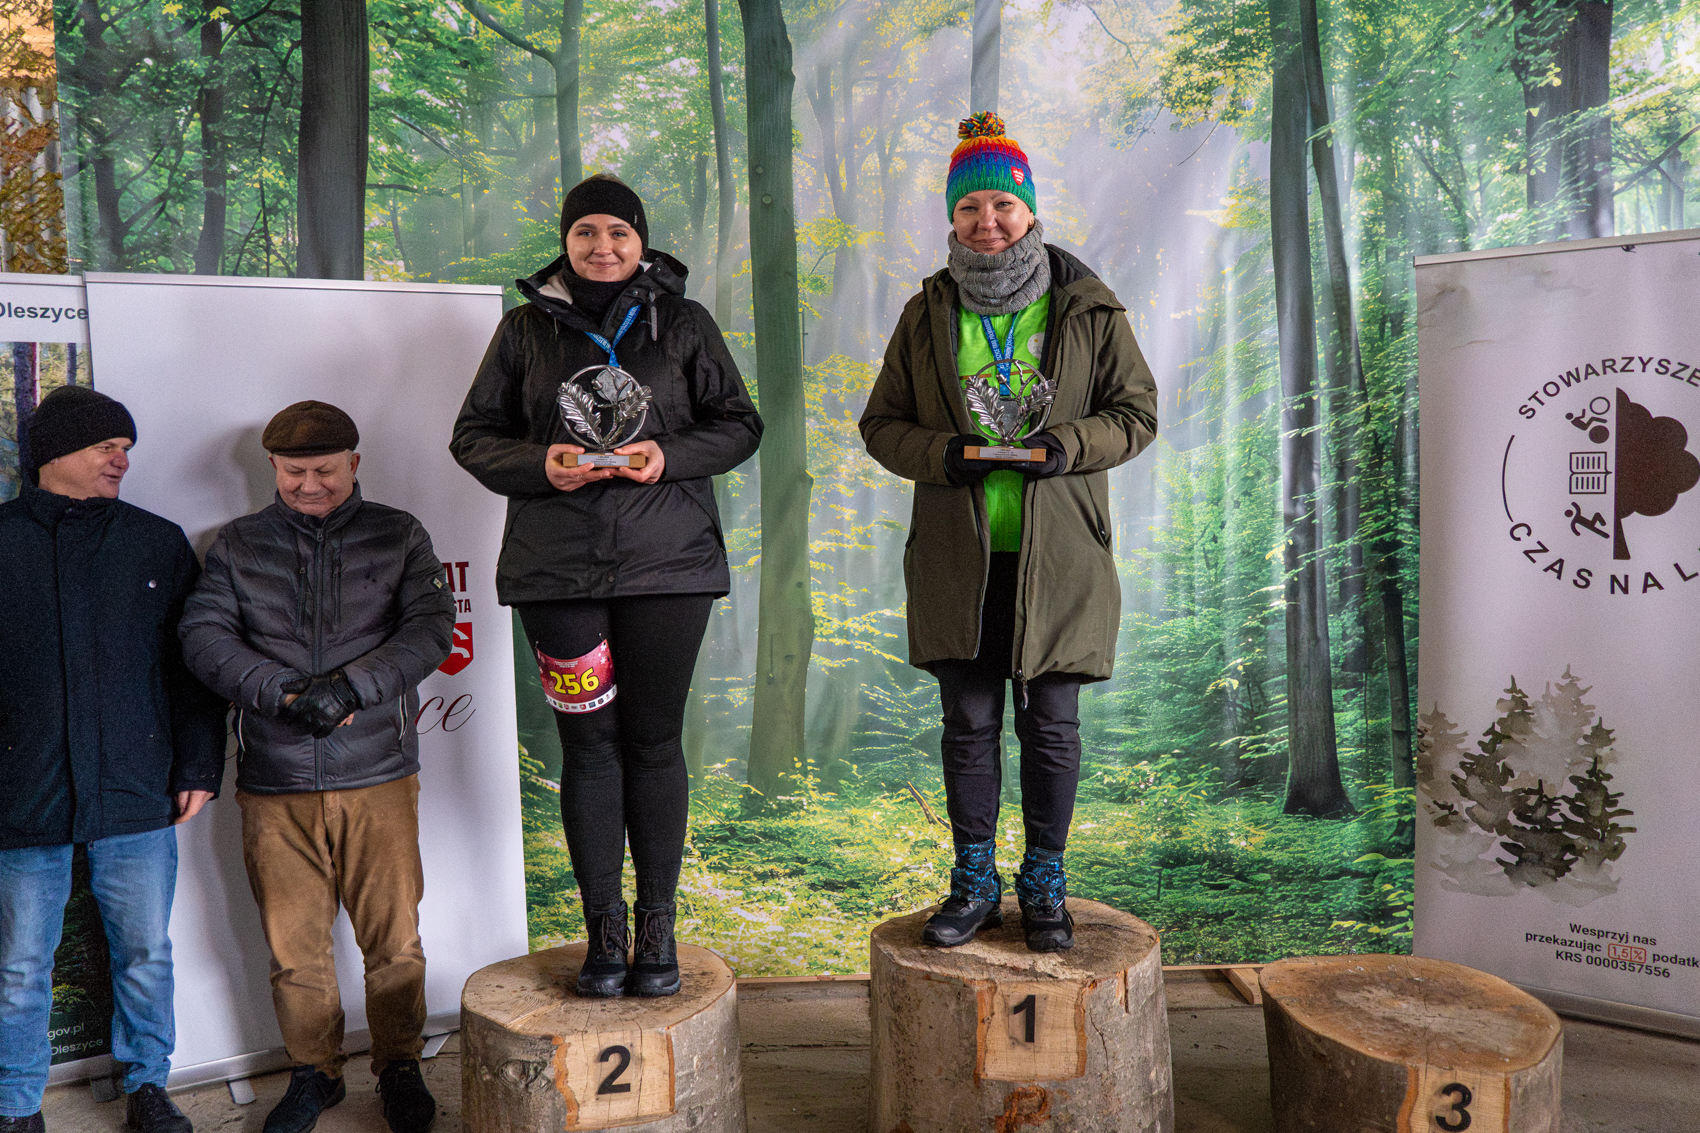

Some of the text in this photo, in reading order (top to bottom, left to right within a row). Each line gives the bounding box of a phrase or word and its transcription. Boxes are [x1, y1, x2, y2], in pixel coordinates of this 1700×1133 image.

[1518, 356, 1700, 420] STOWARZYSZE
[549, 666, 600, 695] 256
[1525, 932, 1602, 952] przekazując
[1652, 952, 1700, 968] podatk
[1569, 922, 1657, 946] Wesprzyj nas
[1555, 950, 1671, 978] KRS 0000357556
[47, 1022, 85, 1040] gov.pl
[1013, 994, 1036, 1043] 1
[597, 1044, 631, 1095] 2
[1435, 1083, 1472, 1132] 3
